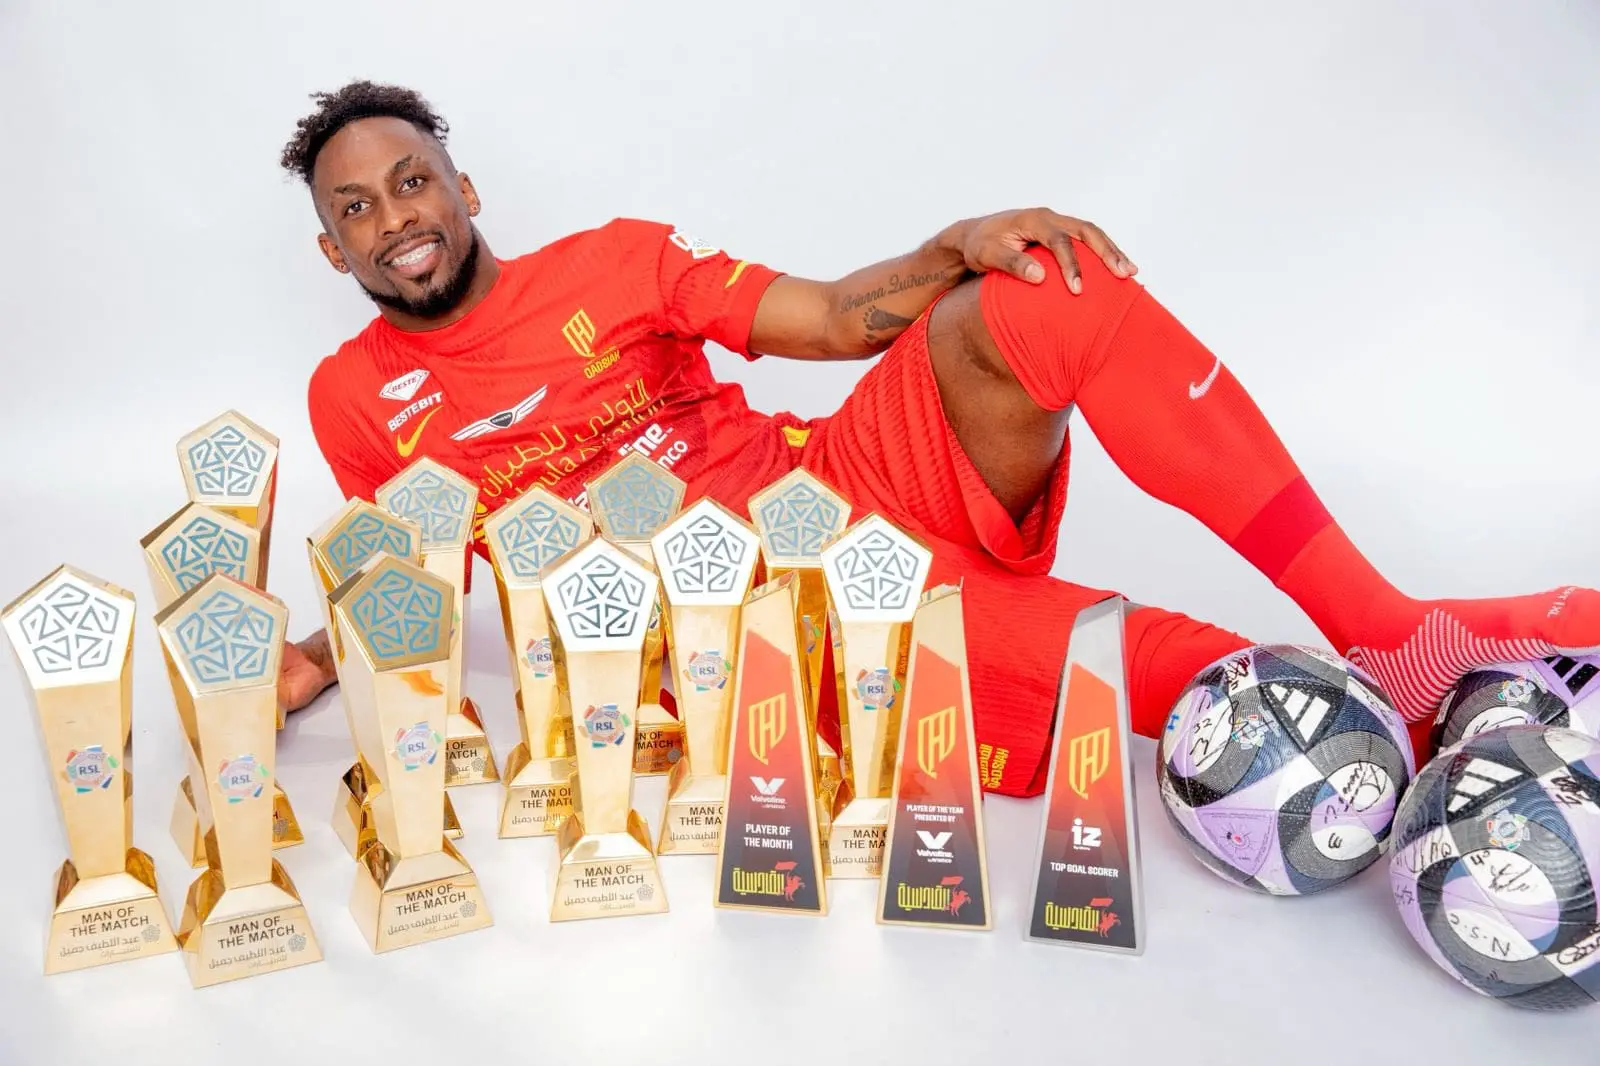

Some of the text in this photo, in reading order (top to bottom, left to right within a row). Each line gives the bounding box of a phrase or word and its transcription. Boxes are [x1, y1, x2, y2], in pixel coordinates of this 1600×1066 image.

[584, 349, 621, 379] QADSIAH
[391, 376, 417, 392] BESTE
[387, 391, 443, 432] BESTEBIT
[482, 424, 567, 497] للطيران
[699, 666, 718, 675] RSL
[867, 685, 886, 694] RSL
[595, 721, 615, 731] RSL
[407, 741, 427, 753] RSL
[452, 740, 467, 750] OF
[78, 764, 101, 776] RSL
[230, 774, 253, 785] RSL
[531, 789, 556, 798] MAN
[520, 799, 544, 809] THE
[689, 806, 715, 816] MAN
[680, 816, 703, 826] THE
[745, 823, 791, 836] PLAYER OF
[853, 829, 879, 839] MAN
[743, 836, 793, 850] THE MONTH
[843, 839, 866, 849] THE
[584, 864, 632, 877] MAN OF
[1050, 861, 1119, 878] TOP GOAL SCORER
[574, 874, 645, 889] THE MATCH
[406, 883, 454, 903] MAN OF
[396, 891, 466, 916] THE MATCH
[81, 906, 135, 925] MAN OF
[69, 915, 149, 938] THE MATCH
[229, 915, 281, 936] MAN OF
[218, 924, 295, 949] THE MATCH
